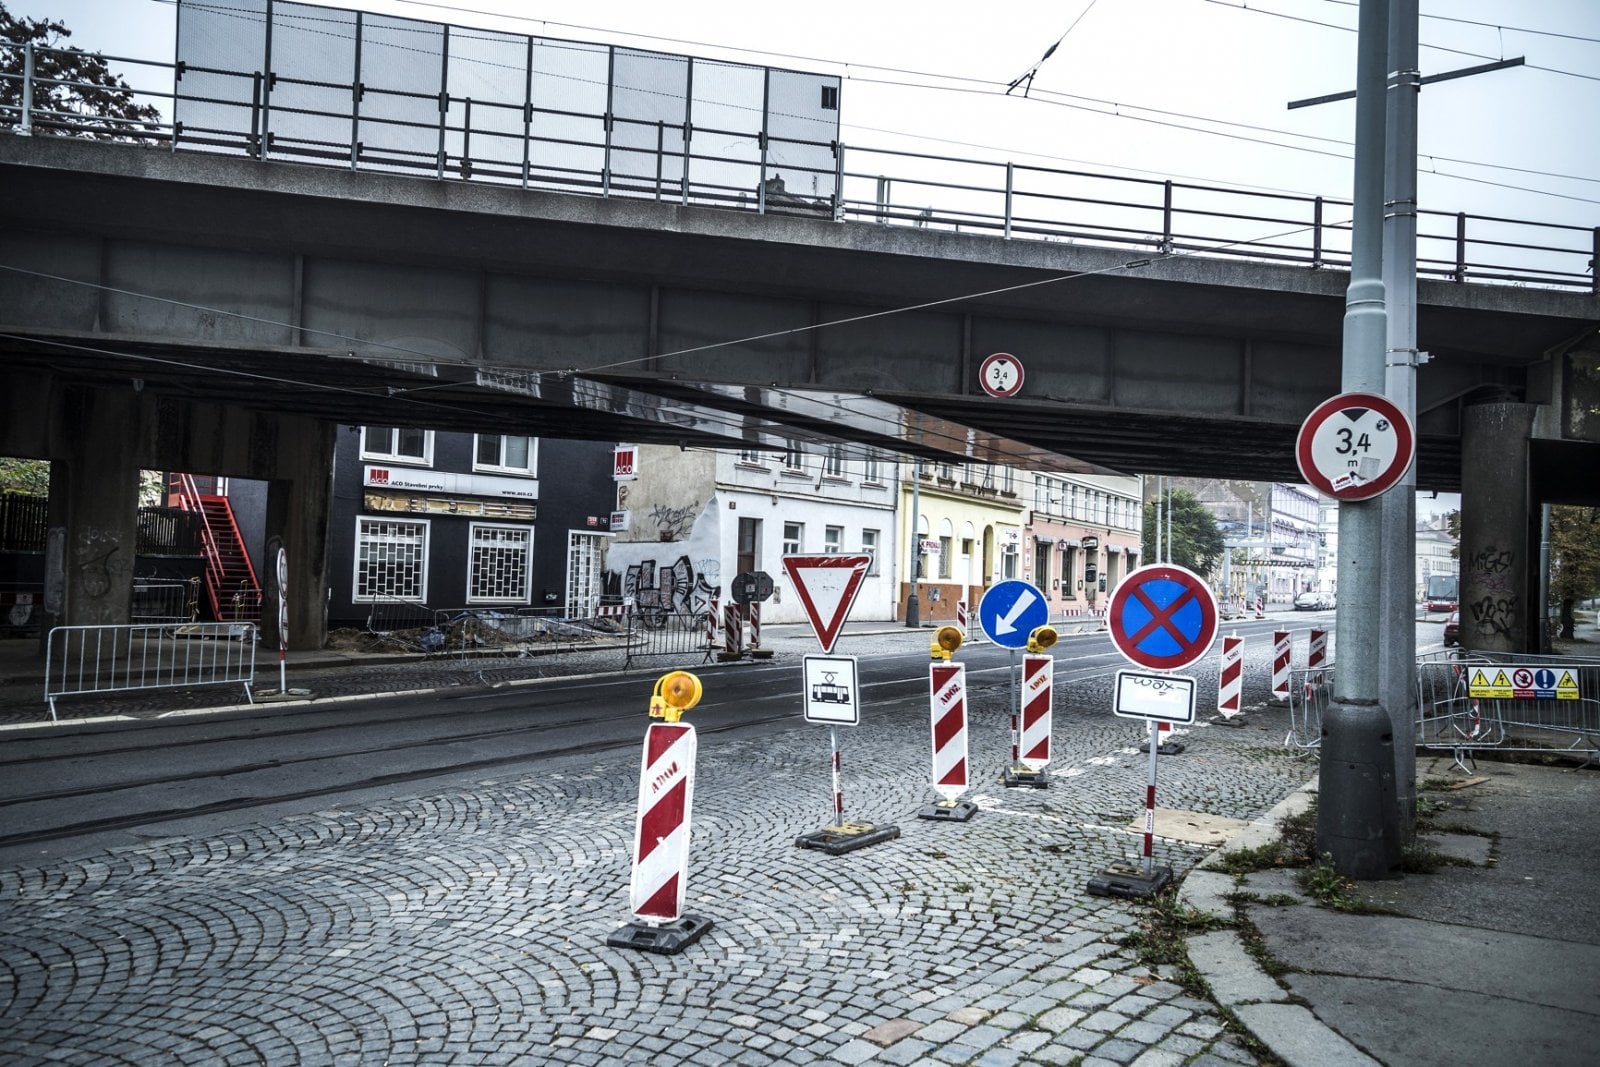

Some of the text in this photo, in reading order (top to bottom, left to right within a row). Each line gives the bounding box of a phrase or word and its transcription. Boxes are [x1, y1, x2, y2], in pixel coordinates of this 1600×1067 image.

[1335, 427, 1371, 456] 3,4
[1347, 459, 1358, 467] m
[616, 465, 632, 474] ACO
